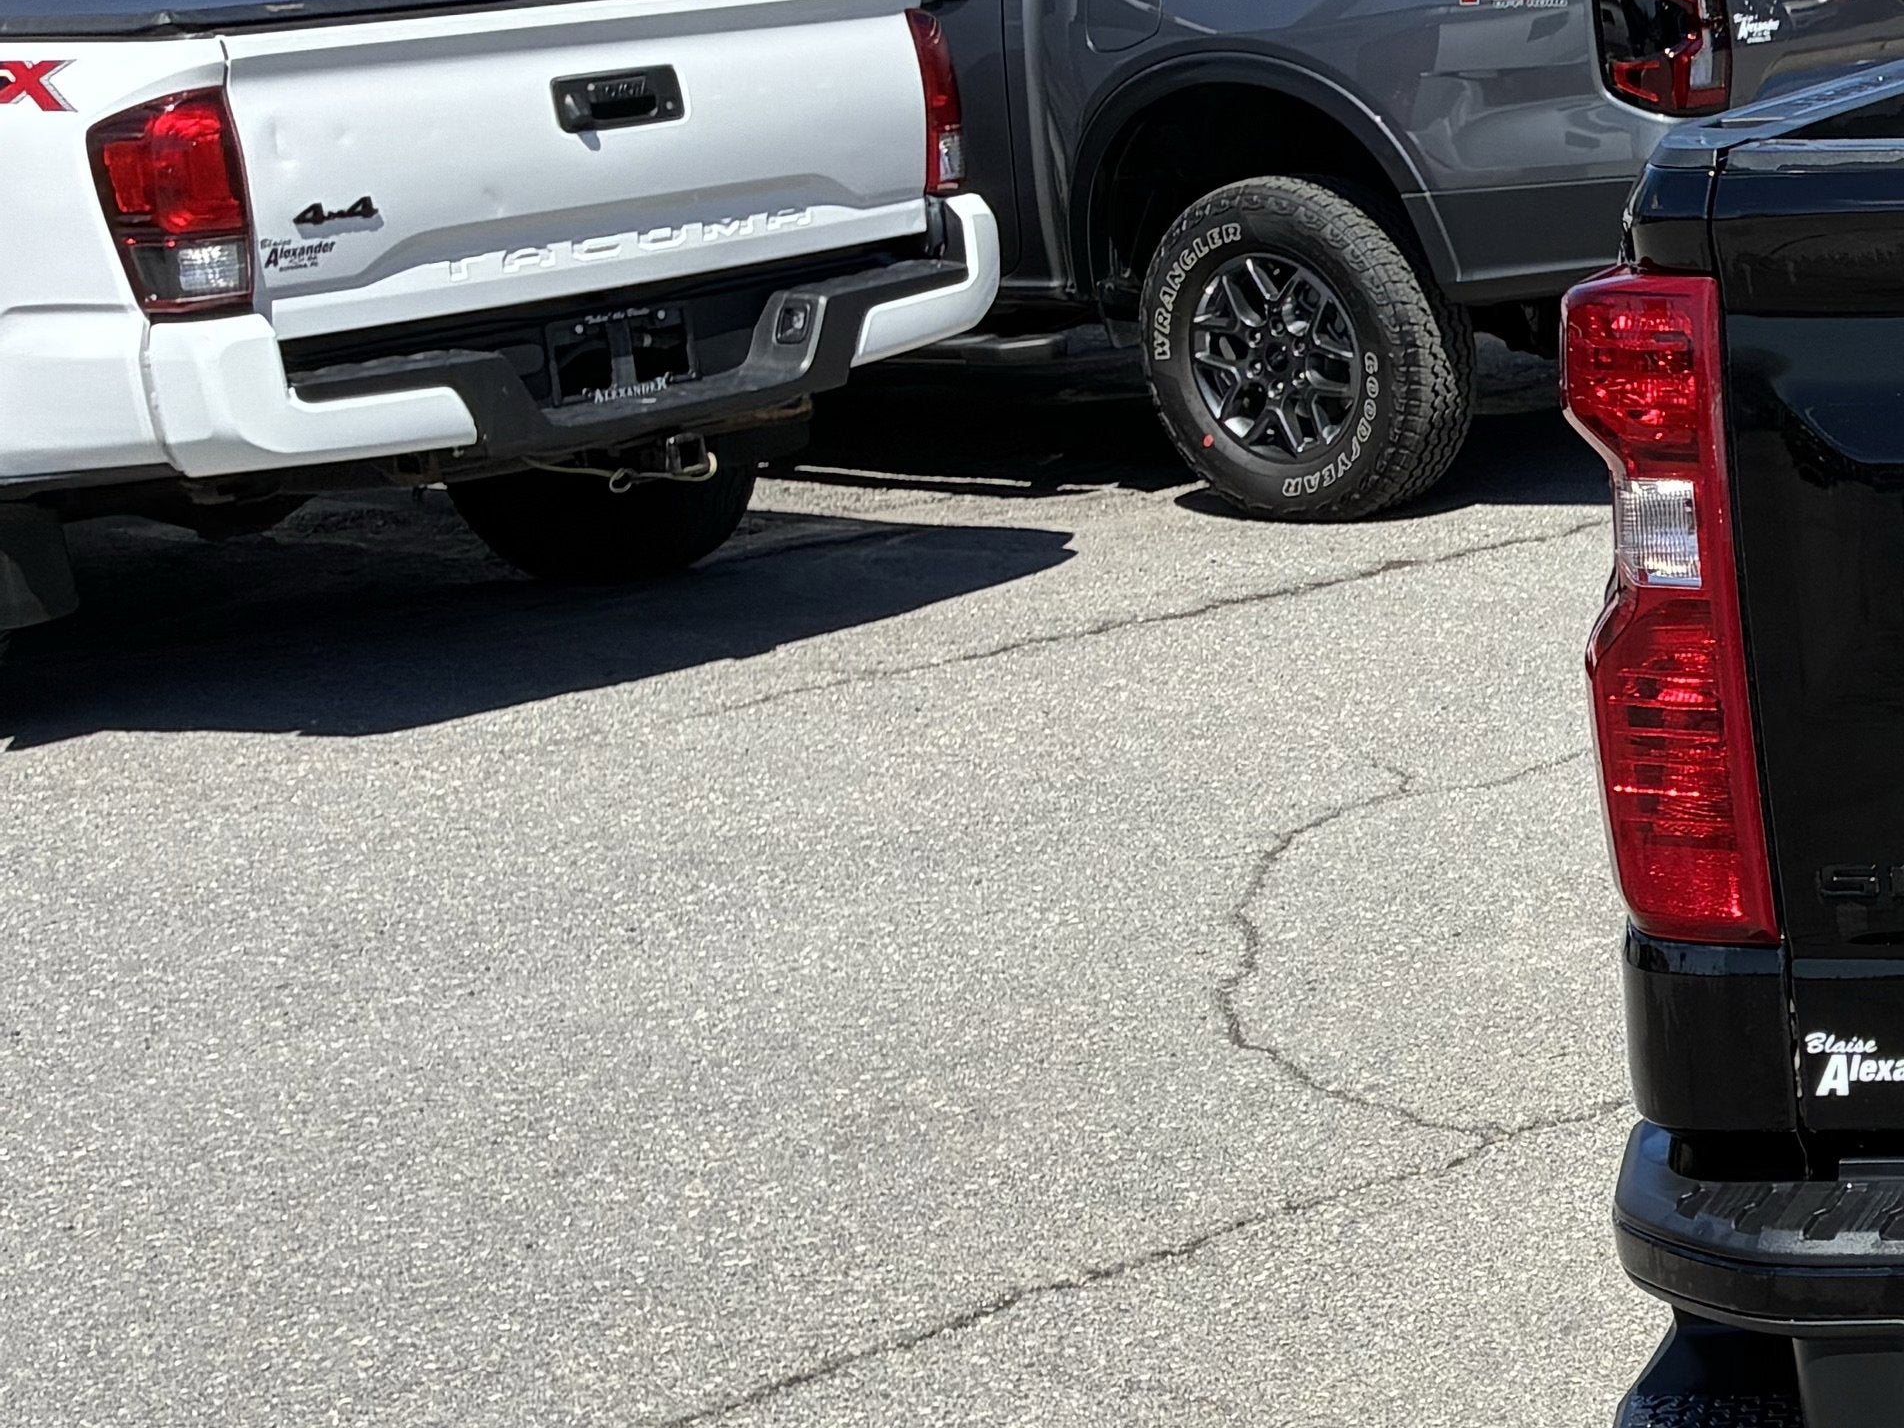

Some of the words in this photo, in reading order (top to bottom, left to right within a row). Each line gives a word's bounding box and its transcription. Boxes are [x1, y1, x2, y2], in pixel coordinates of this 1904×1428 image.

[264, 241, 336, 269] Alexander
[440, 206, 814, 283] TACOMA
[1153, 222, 1243, 361] WRANGLER
[1282, 351, 1380, 498] GOODYEAR
[1804, 1031, 1878, 1055] Blaise
